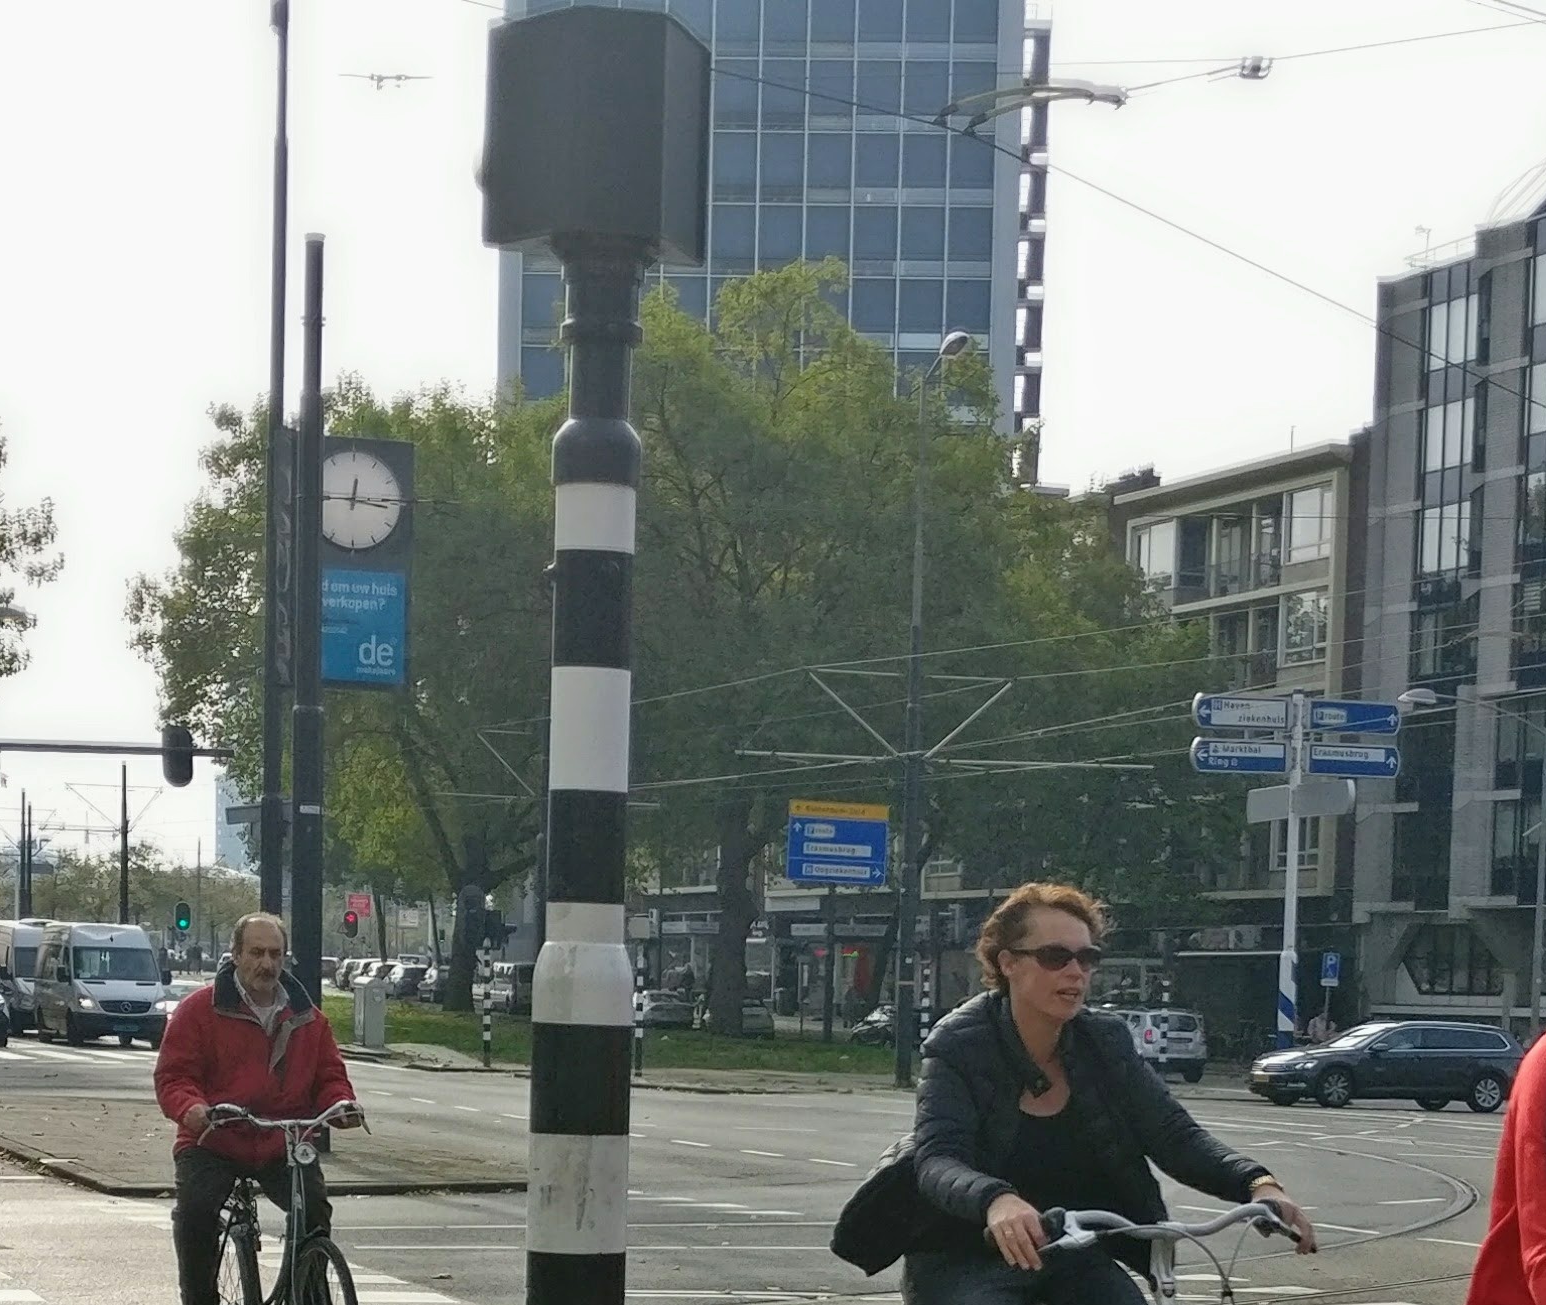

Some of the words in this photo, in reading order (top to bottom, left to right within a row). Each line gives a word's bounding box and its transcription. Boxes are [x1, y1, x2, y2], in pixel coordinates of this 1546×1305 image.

[330, 583, 350, 593] om
[351, 584, 370, 594] uw
[371, 583, 398, 596] huis
[359, 634, 394, 666] de
[1238, 713, 1285, 724] ziekenhuis
[1313, 747, 1370, 760] Erasmusbrug
[1207, 756, 1230, 768] Ring
